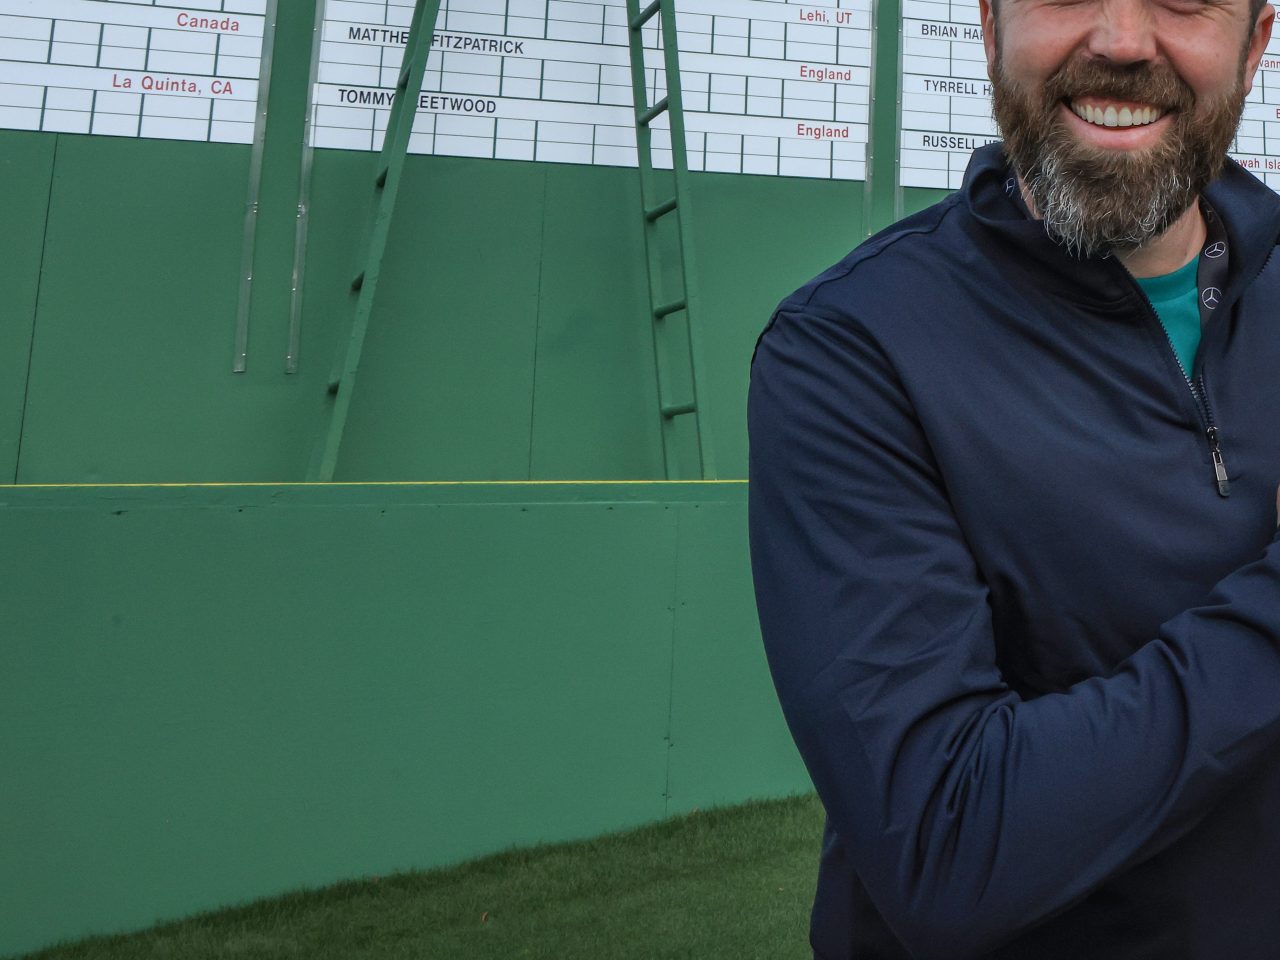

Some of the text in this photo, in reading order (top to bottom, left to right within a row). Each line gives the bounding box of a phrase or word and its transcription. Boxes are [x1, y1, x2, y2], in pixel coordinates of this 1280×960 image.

[176, 12, 240, 32] Canada
[800, 9, 852, 24] Lehi, UT
[922, 24, 957, 37] BRIAN
[348, 27, 523, 55] MATTHE FITZPATRICK
[800, 64, 851, 81] England
[112, 74, 234, 96] La Quinta, CA
[924, 80, 977, 94] TYRRELL
[336, 89, 395, 108] TOMMY
[796, 123, 849, 140] England
[923, 135, 977, 151] RUSSELL
